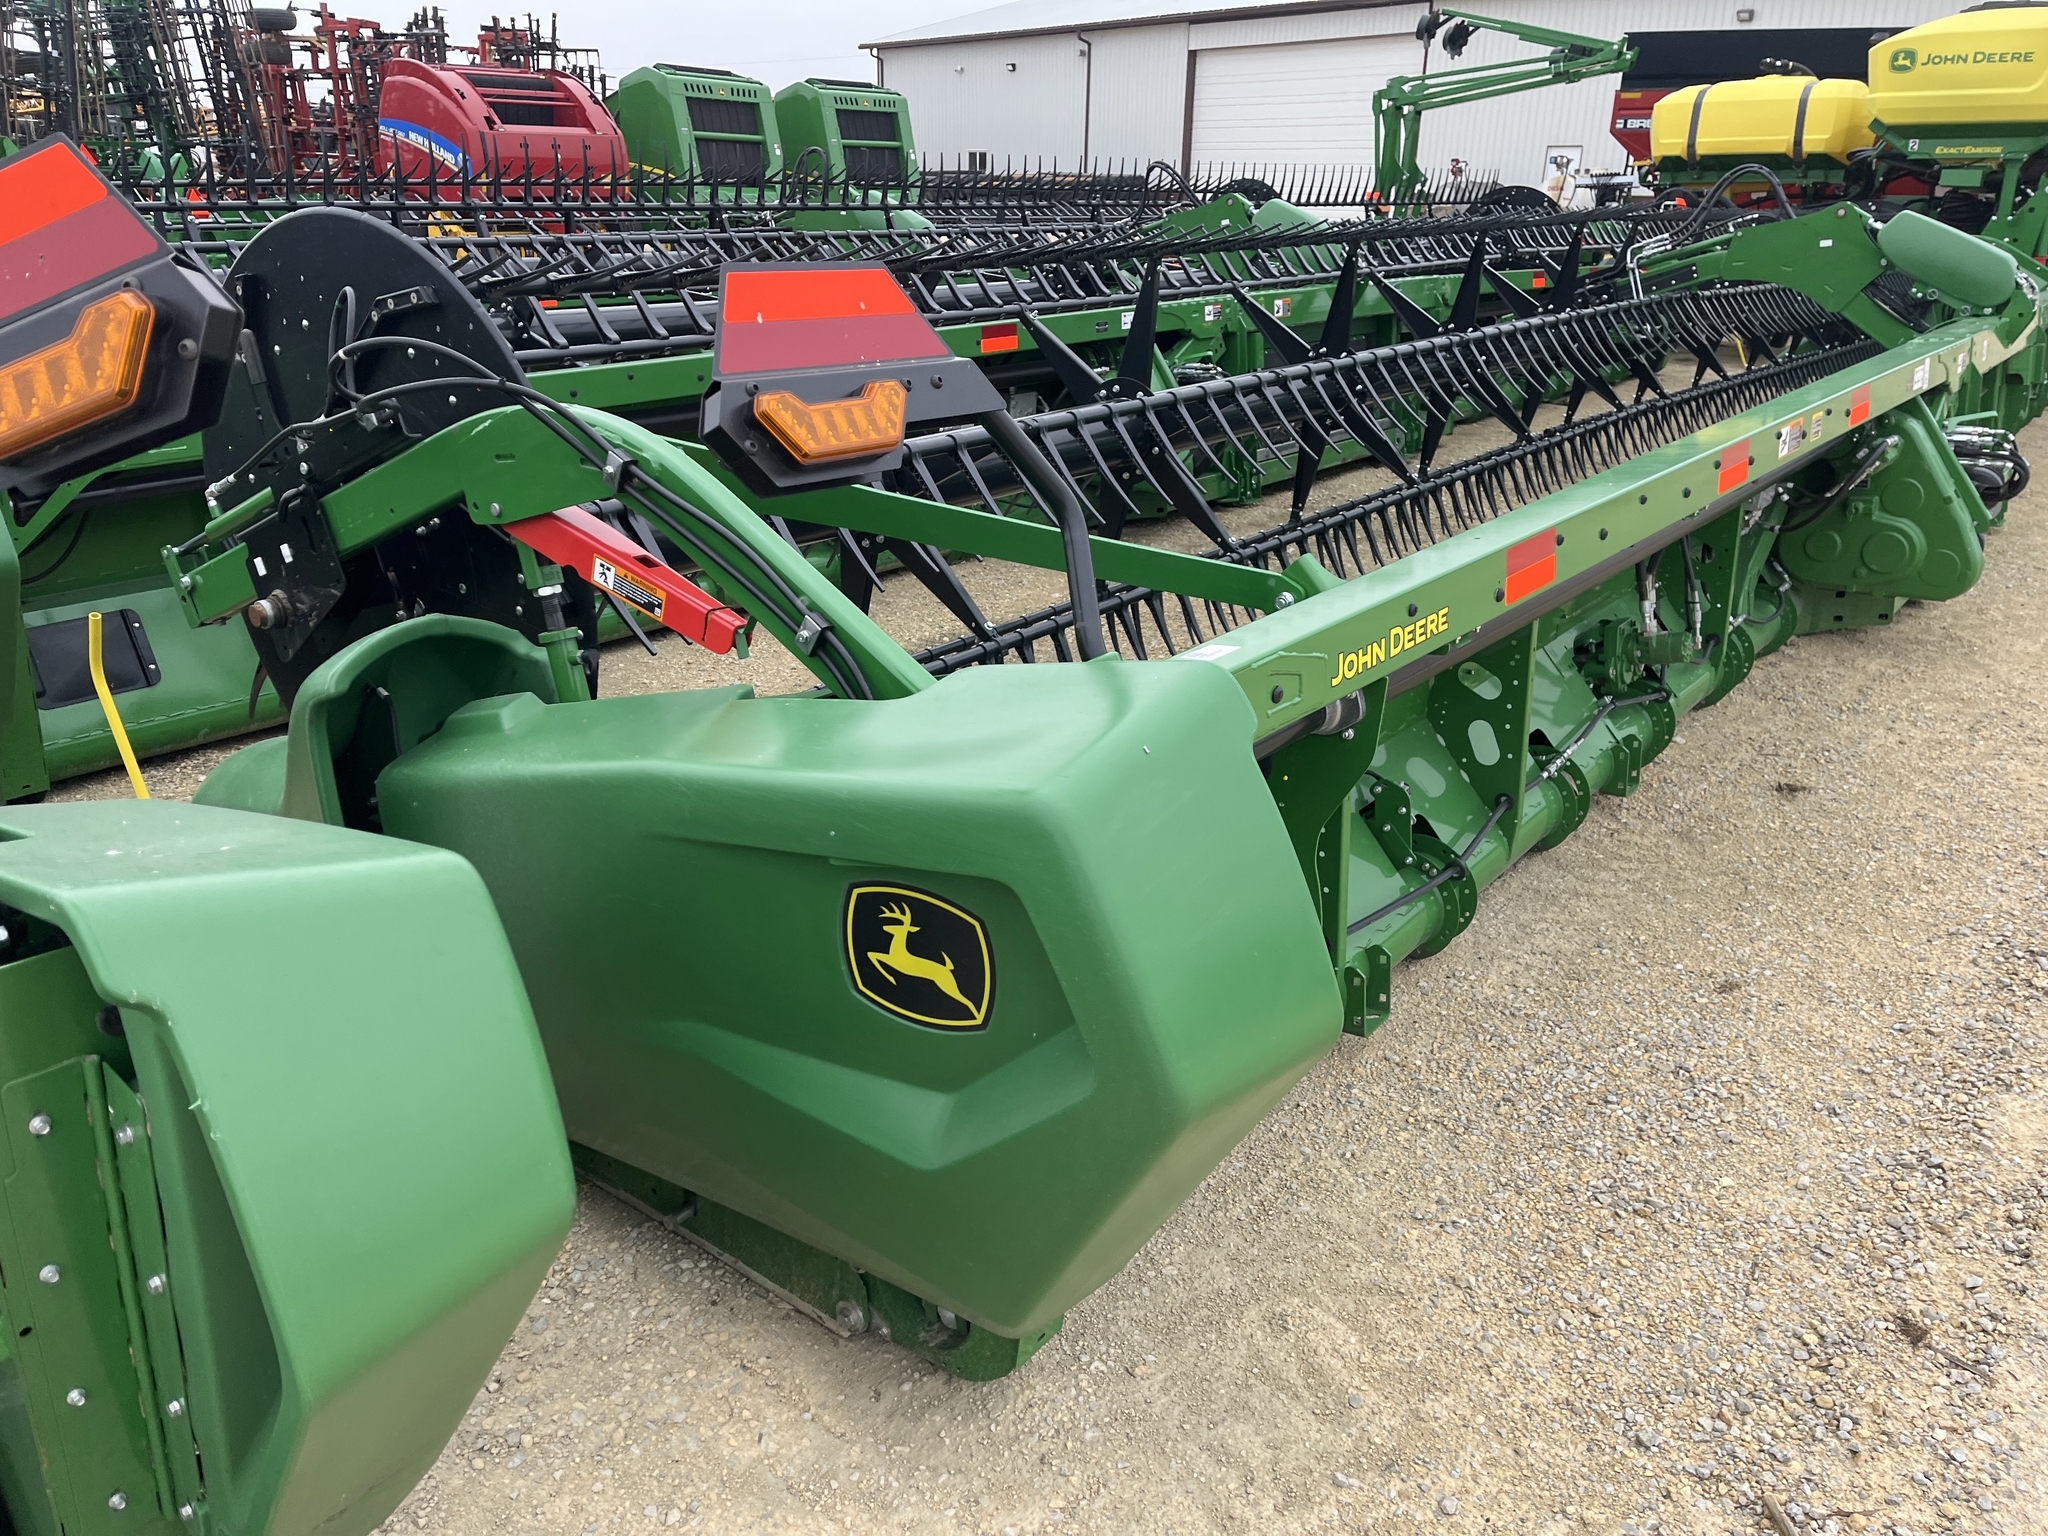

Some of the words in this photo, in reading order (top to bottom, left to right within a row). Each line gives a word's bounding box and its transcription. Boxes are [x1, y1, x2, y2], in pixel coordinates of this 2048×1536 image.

[1921, 53, 1968, 67] JOHN
[1972, 51, 2036, 64] DEERE
[408, 130, 424, 145] NEW
[1910, 140, 1917, 151] 2
[630, 574, 658, 595] WARNING
[1331, 637, 1387, 688] JOHN
[1389, 606, 1450, 658] DEERE
